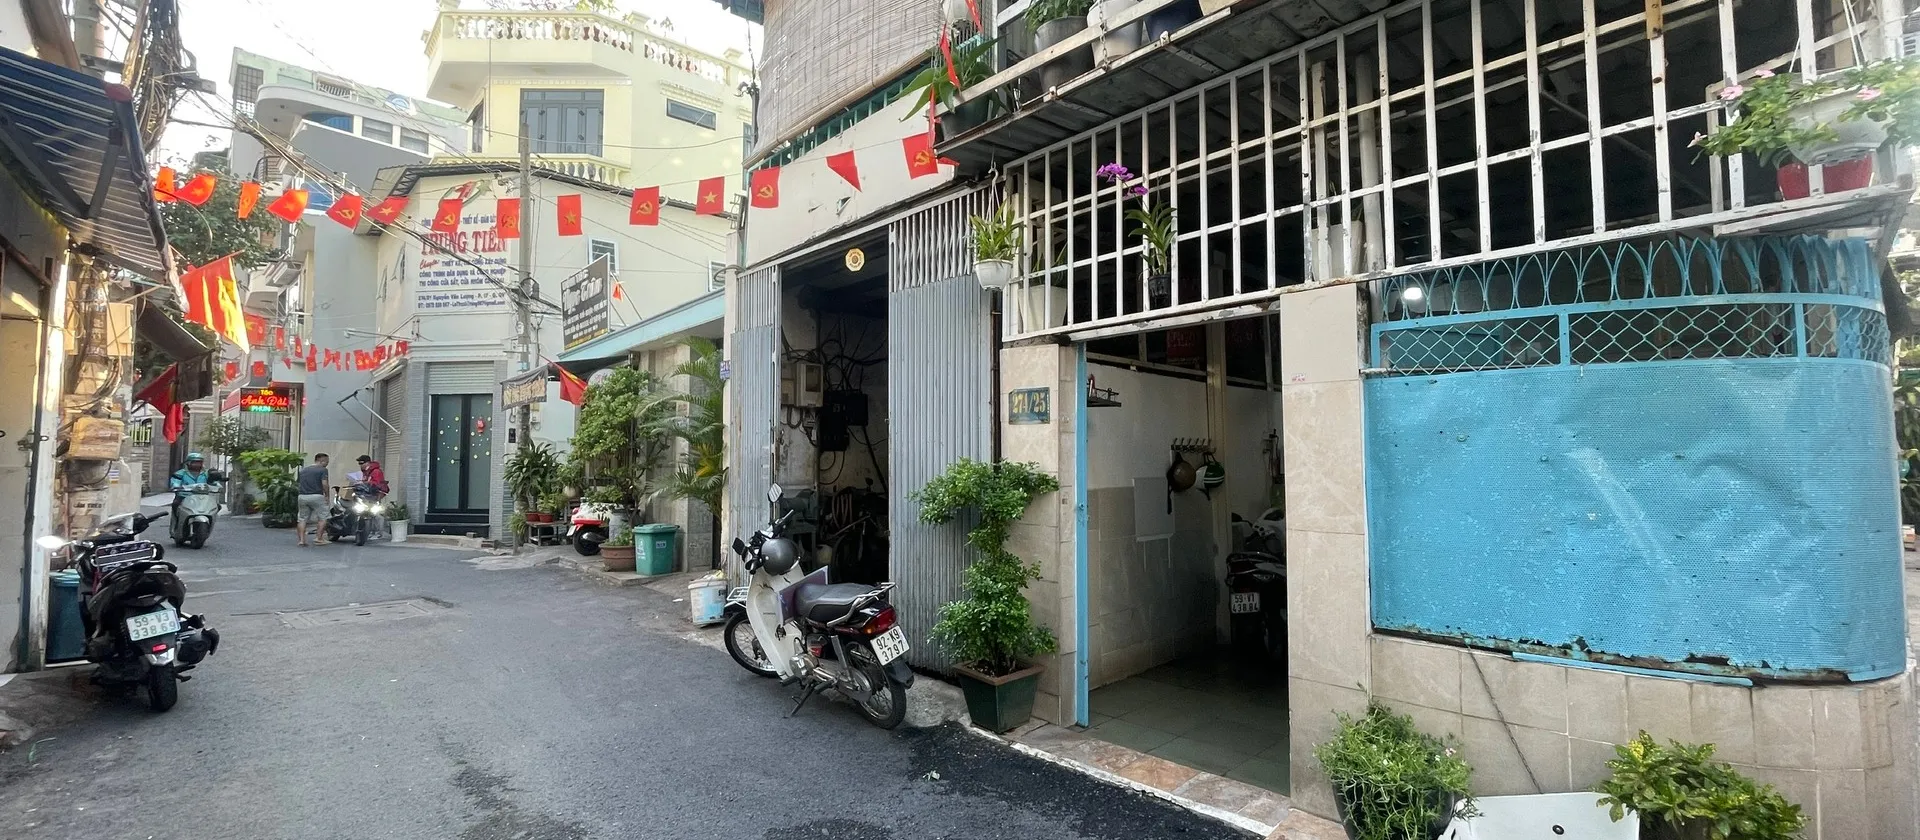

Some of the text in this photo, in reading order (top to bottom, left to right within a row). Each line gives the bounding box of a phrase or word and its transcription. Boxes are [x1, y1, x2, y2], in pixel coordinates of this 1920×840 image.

[421, 231, 468, 255] TRUNG
[419, 270, 432, 278] CÔNG
[241, 395, 266, 405] Anh
[134, 612, 169, 627] 59-V3
[876, 629, 900, 650] 92-K9
[882, 640, 905, 662] 3797
